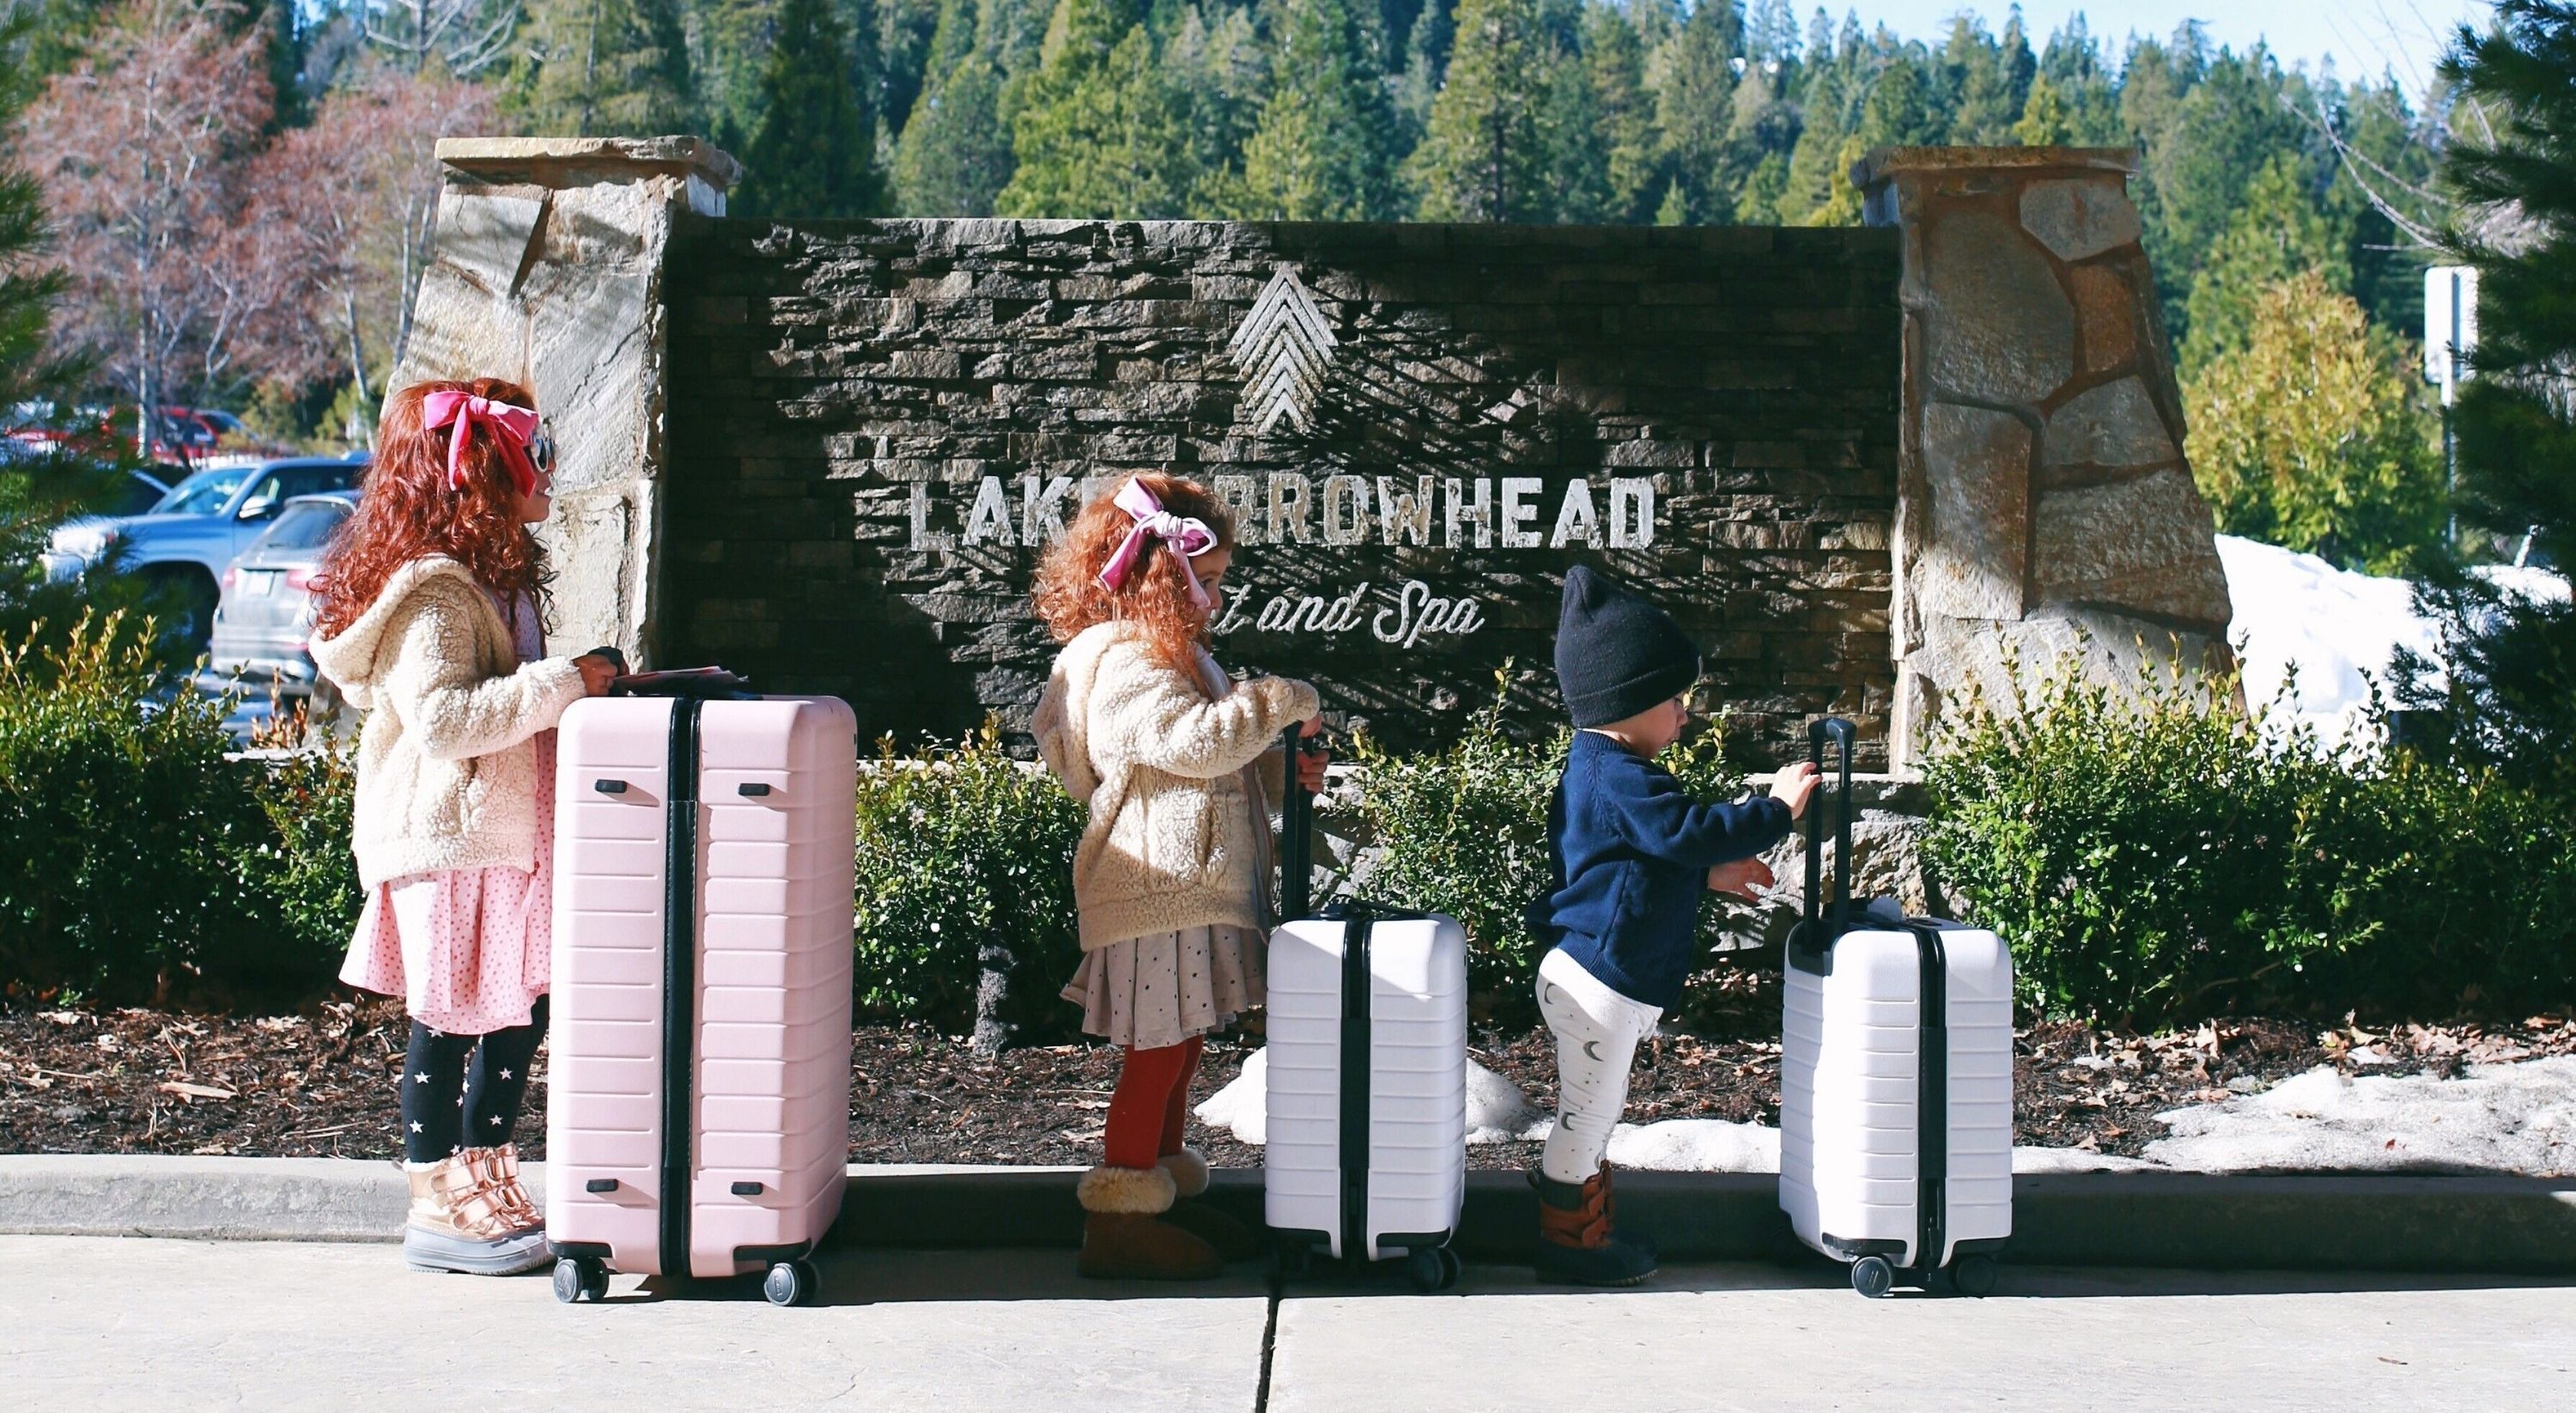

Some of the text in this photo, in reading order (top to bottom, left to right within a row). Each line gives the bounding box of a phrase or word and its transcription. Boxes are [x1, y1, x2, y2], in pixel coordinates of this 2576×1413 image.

[910, 473, 1656, 551] LAK RROWHEAD
[1256, 582, 1370, 634] and
[1373, 580, 1485, 649] Spa
